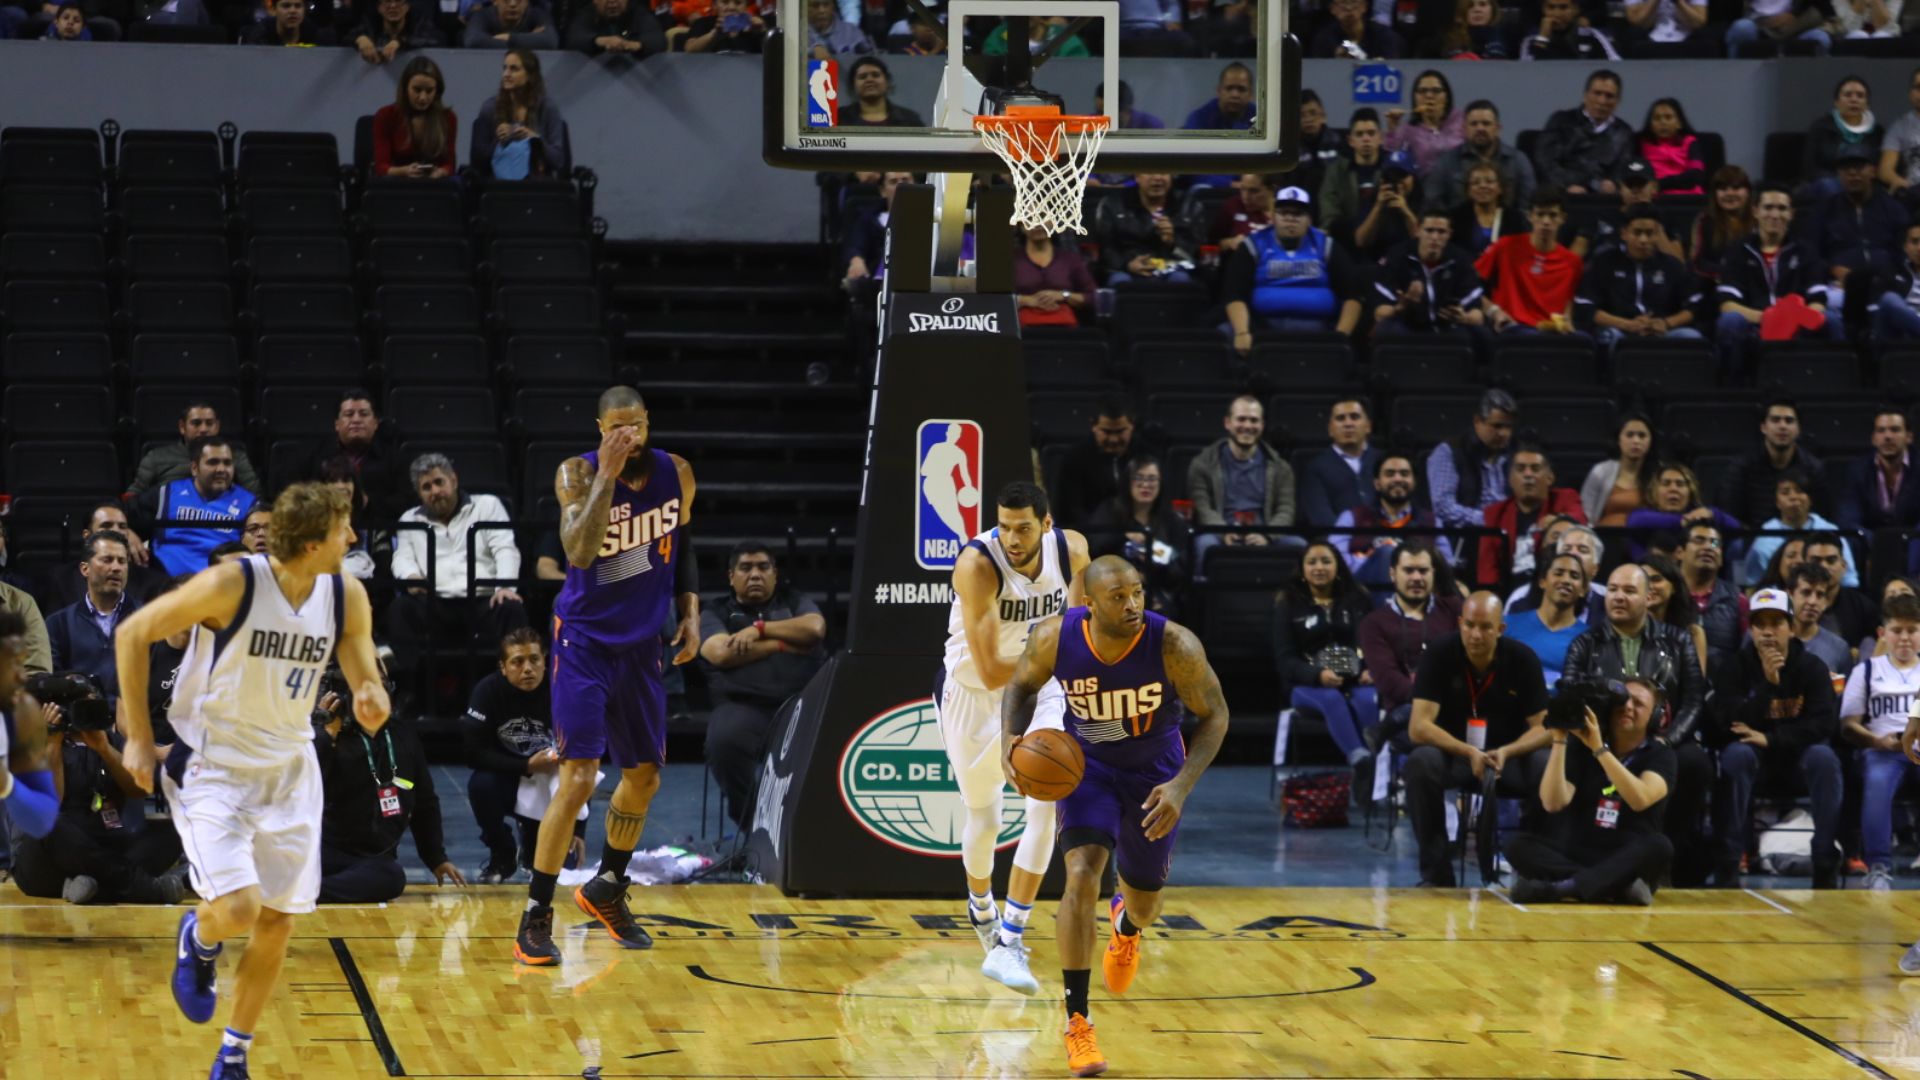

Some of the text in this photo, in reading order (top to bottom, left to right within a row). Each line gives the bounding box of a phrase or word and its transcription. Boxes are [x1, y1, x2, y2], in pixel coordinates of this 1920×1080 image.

[1355, 75, 1399, 93] 210
[811, 113, 829, 123] NBA
[799, 138, 846, 148] SPALDING
[908, 311, 999, 333] SPALDING
[609, 502, 631, 523] OS
[658, 534, 672, 564] 4
[924, 539, 960, 559] NBA
[1000, 587, 1063, 621] DALLAS
[248, 629, 328, 663] DALLAS
[286, 666, 317, 700] 41
[1062, 677, 1098, 695] LOS
[861, 762, 903, 781] CD.
[908, 763, 941, 781] DE
